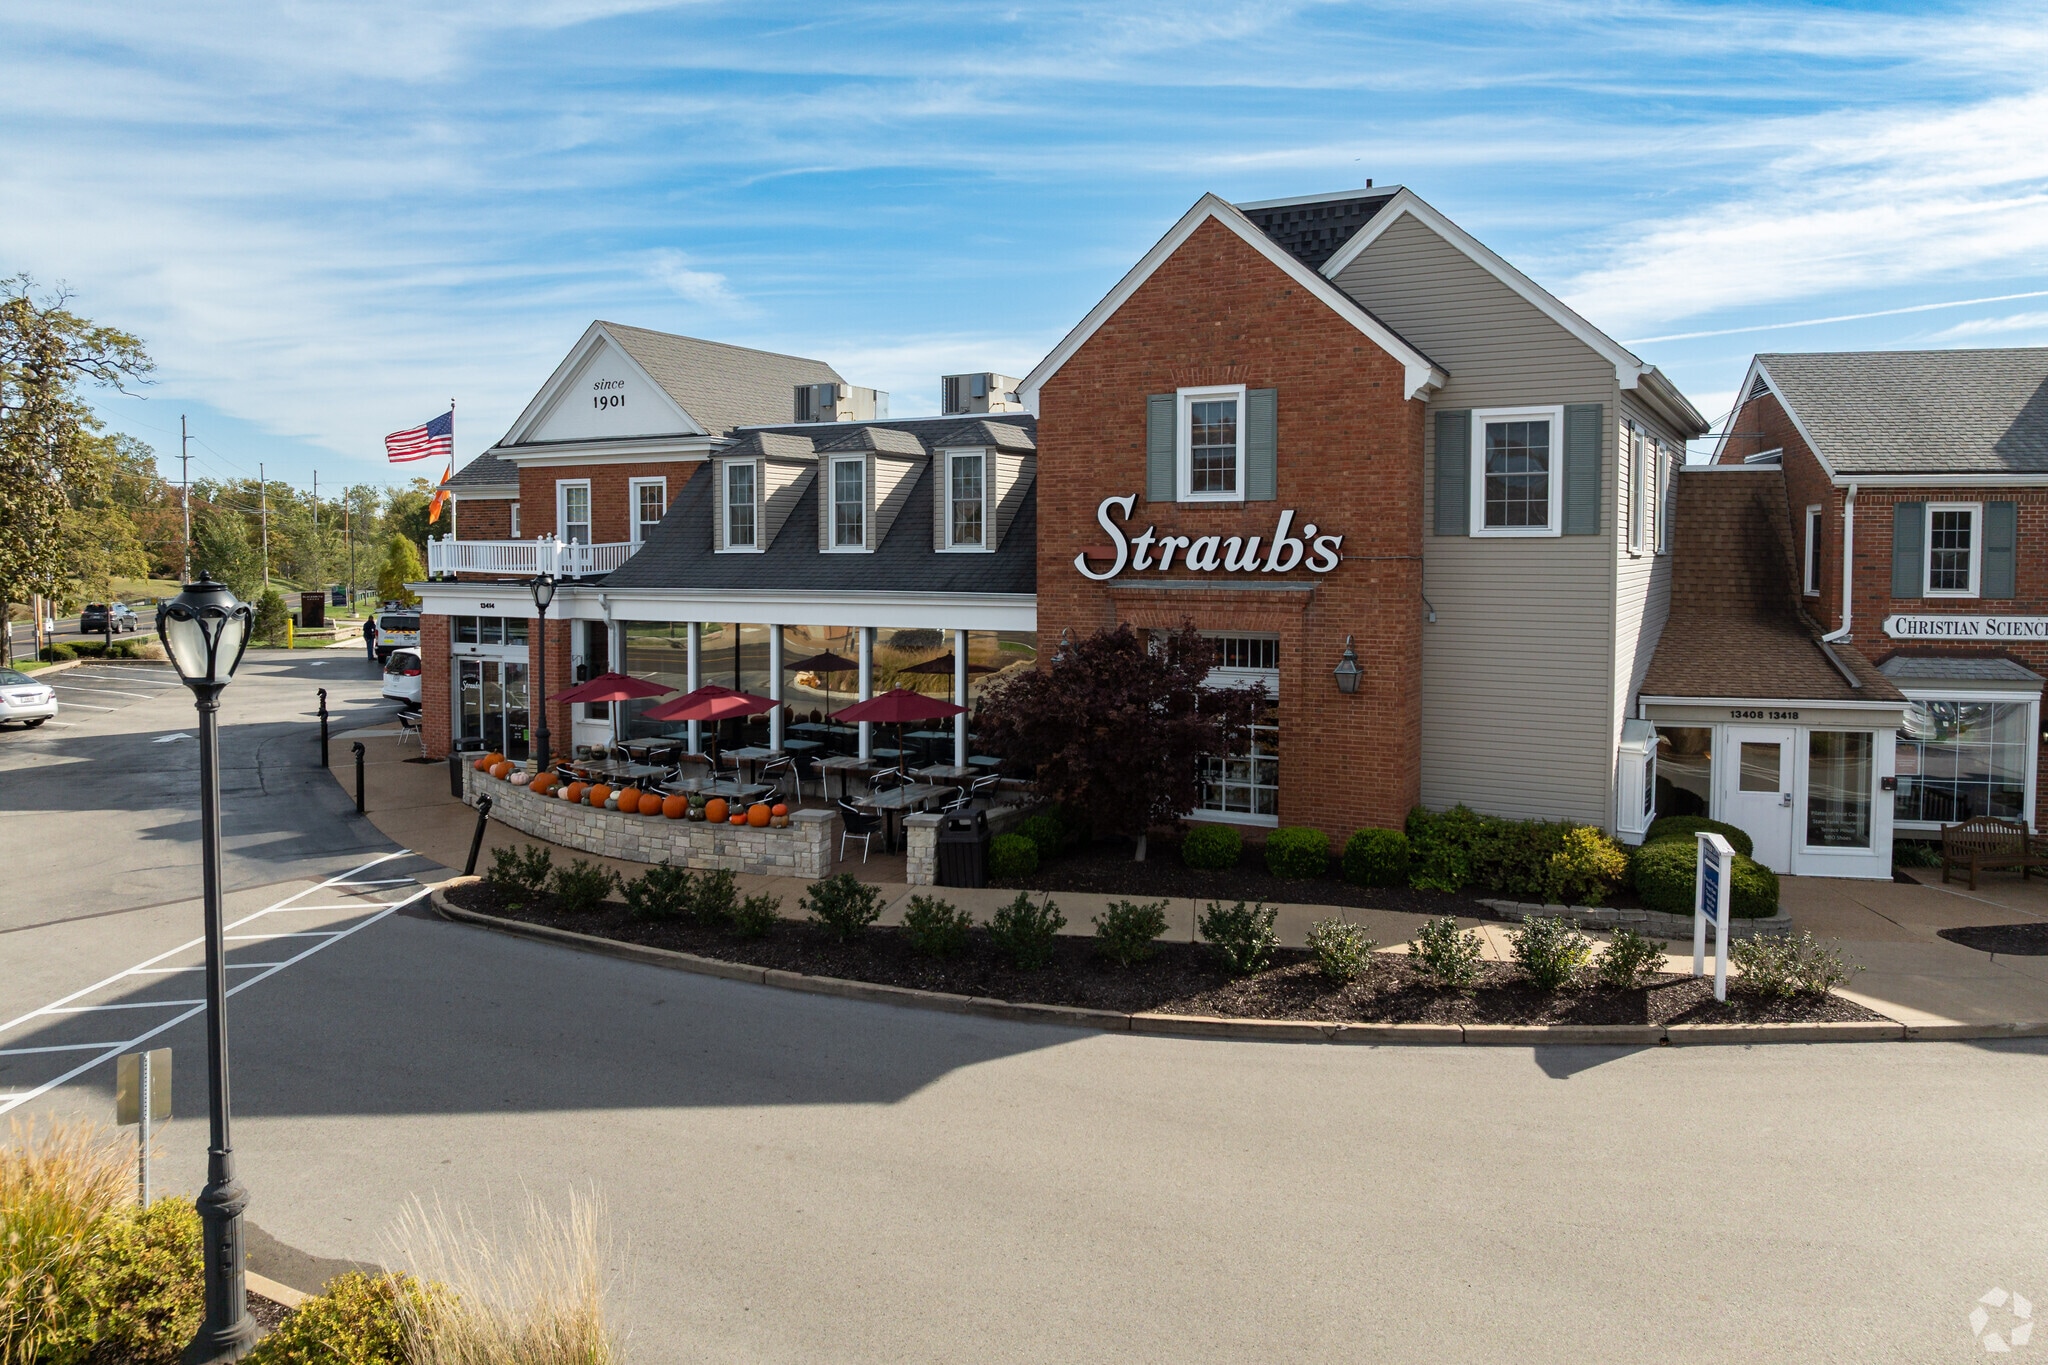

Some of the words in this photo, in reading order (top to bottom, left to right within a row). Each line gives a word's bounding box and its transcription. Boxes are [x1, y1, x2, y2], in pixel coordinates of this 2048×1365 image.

[593, 378, 625, 391] since
[593, 394, 625, 411] 1901
[1073, 493, 1344, 581] Straub's
[1895, 617, 1980, 635] CHRISTIAN
[460, 680, 480, 692] Straub
[1730, 710, 1764, 719] 13408
[1768, 711, 1799, 720] 13418
